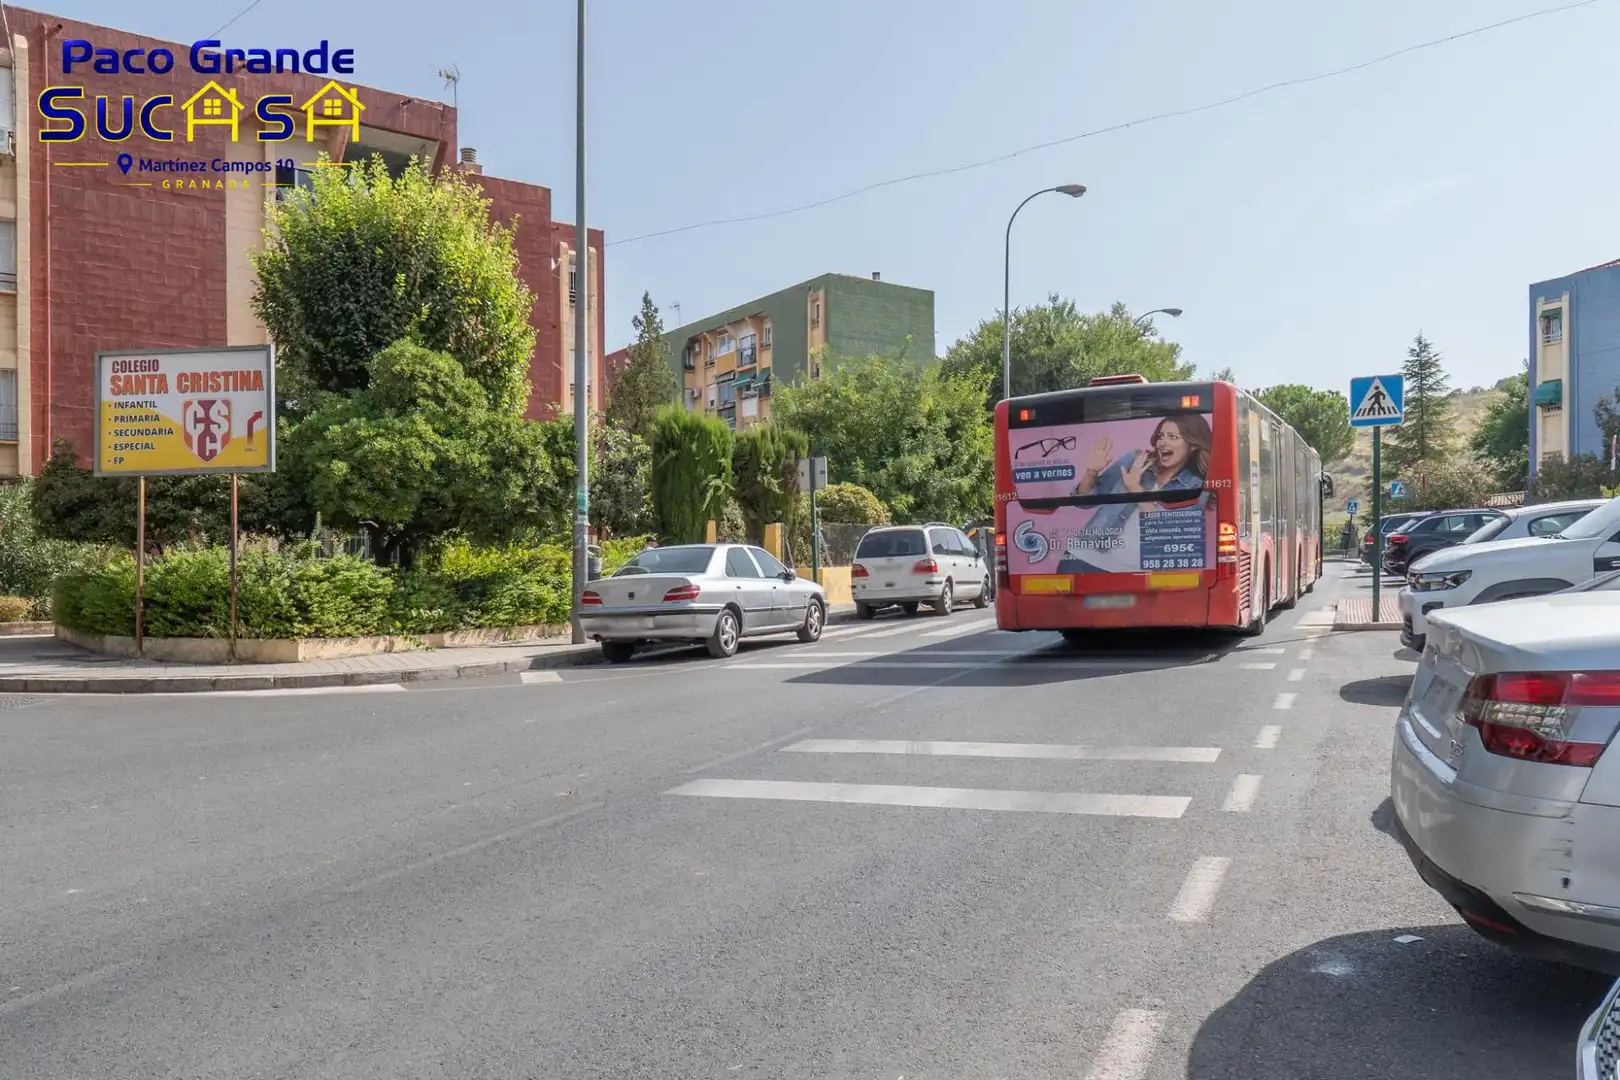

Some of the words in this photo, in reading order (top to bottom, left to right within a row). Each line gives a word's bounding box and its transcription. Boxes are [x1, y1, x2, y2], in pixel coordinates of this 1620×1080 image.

[112, 359, 159, 373] COLEGIO
[110, 373, 169, 396] SANTA
[176, 370, 264, 393] CRISTINA
[114, 400, 158, 409] INFANTIL
[114, 414, 160, 423] PRIMARIA
[114, 427, 174, 437] SECUNDARIA
[114, 442, 155, 451] ESPECIAL
[113, 456, 125, 465] FP
[1015, 471, 1032, 480] ven
[1034, 471, 1040, 479] a
[1042, 468, 1073, 479] vernos
[1049, 538, 1064, 550] Dr.
[1067, 537, 1125, 550] Benavides
[1163, 543, 1195, 553] 695€
[1143, 559, 1161, 569] 958
[1162, 558, 1175, 568] 28
[1177, 558, 1189, 568] 38
[1191, 558, 1204, 567] 28
